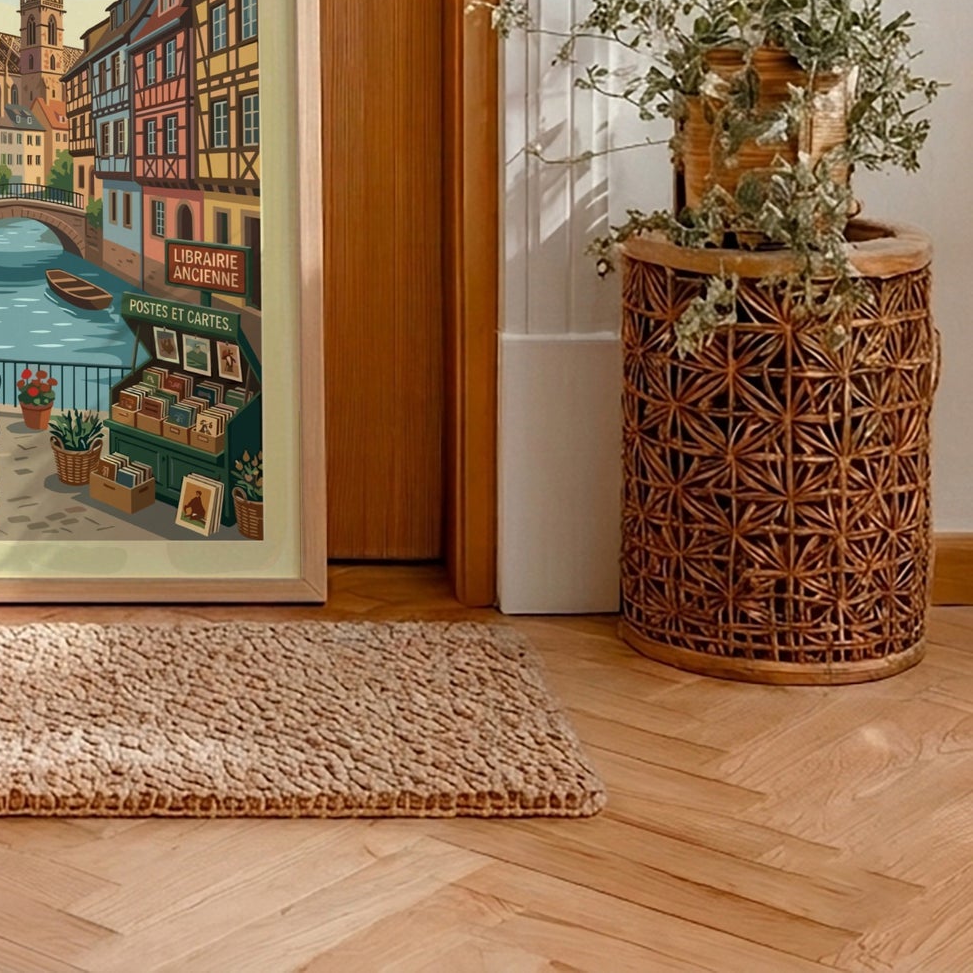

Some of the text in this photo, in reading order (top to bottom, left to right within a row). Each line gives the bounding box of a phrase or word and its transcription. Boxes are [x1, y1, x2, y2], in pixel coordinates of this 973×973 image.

[173, 248, 238, 270] LIBRAIRIE
[173, 265, 239, 288] ANCIENNE
[129, 299, 168, 319] POSTES
[171, 307, 184, 321] ET
